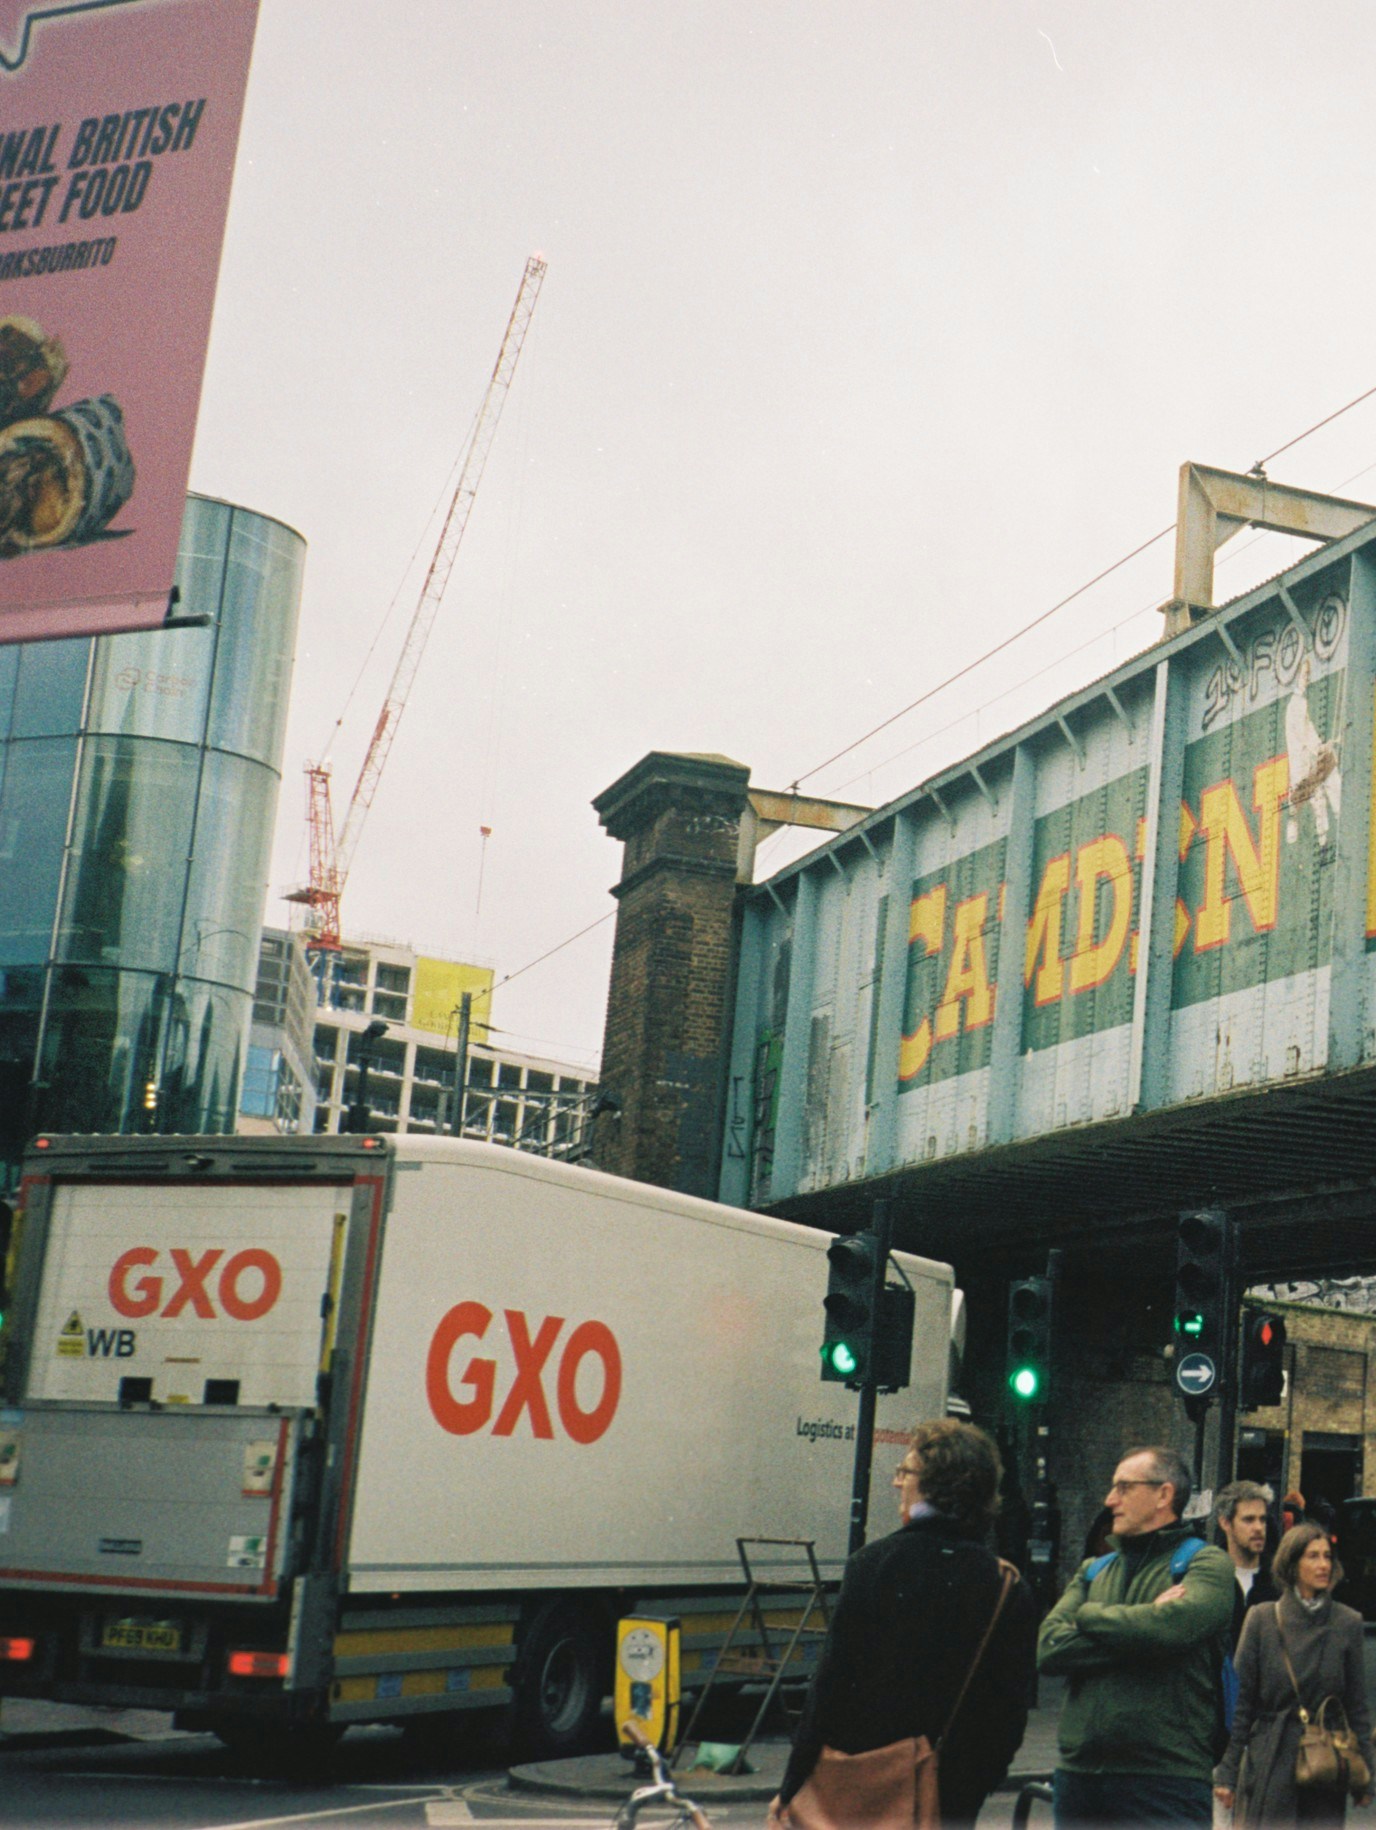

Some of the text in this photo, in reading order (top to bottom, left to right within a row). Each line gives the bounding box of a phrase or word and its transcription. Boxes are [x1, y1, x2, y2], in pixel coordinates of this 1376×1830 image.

[0, 98, 207, 180] NAL BRITISH
[57, 161, 153, 224] FOOD
[0, 236, 117, 280] RKSBURRITO
[107, 1247, 282, 1321] GXO
[87, 1328, 136, 1357] WB
[425, 1300, 623, 1445] GXO
[796, 1416, 843, 1443] Logistics
[844, 1424, 855, 1440] at
